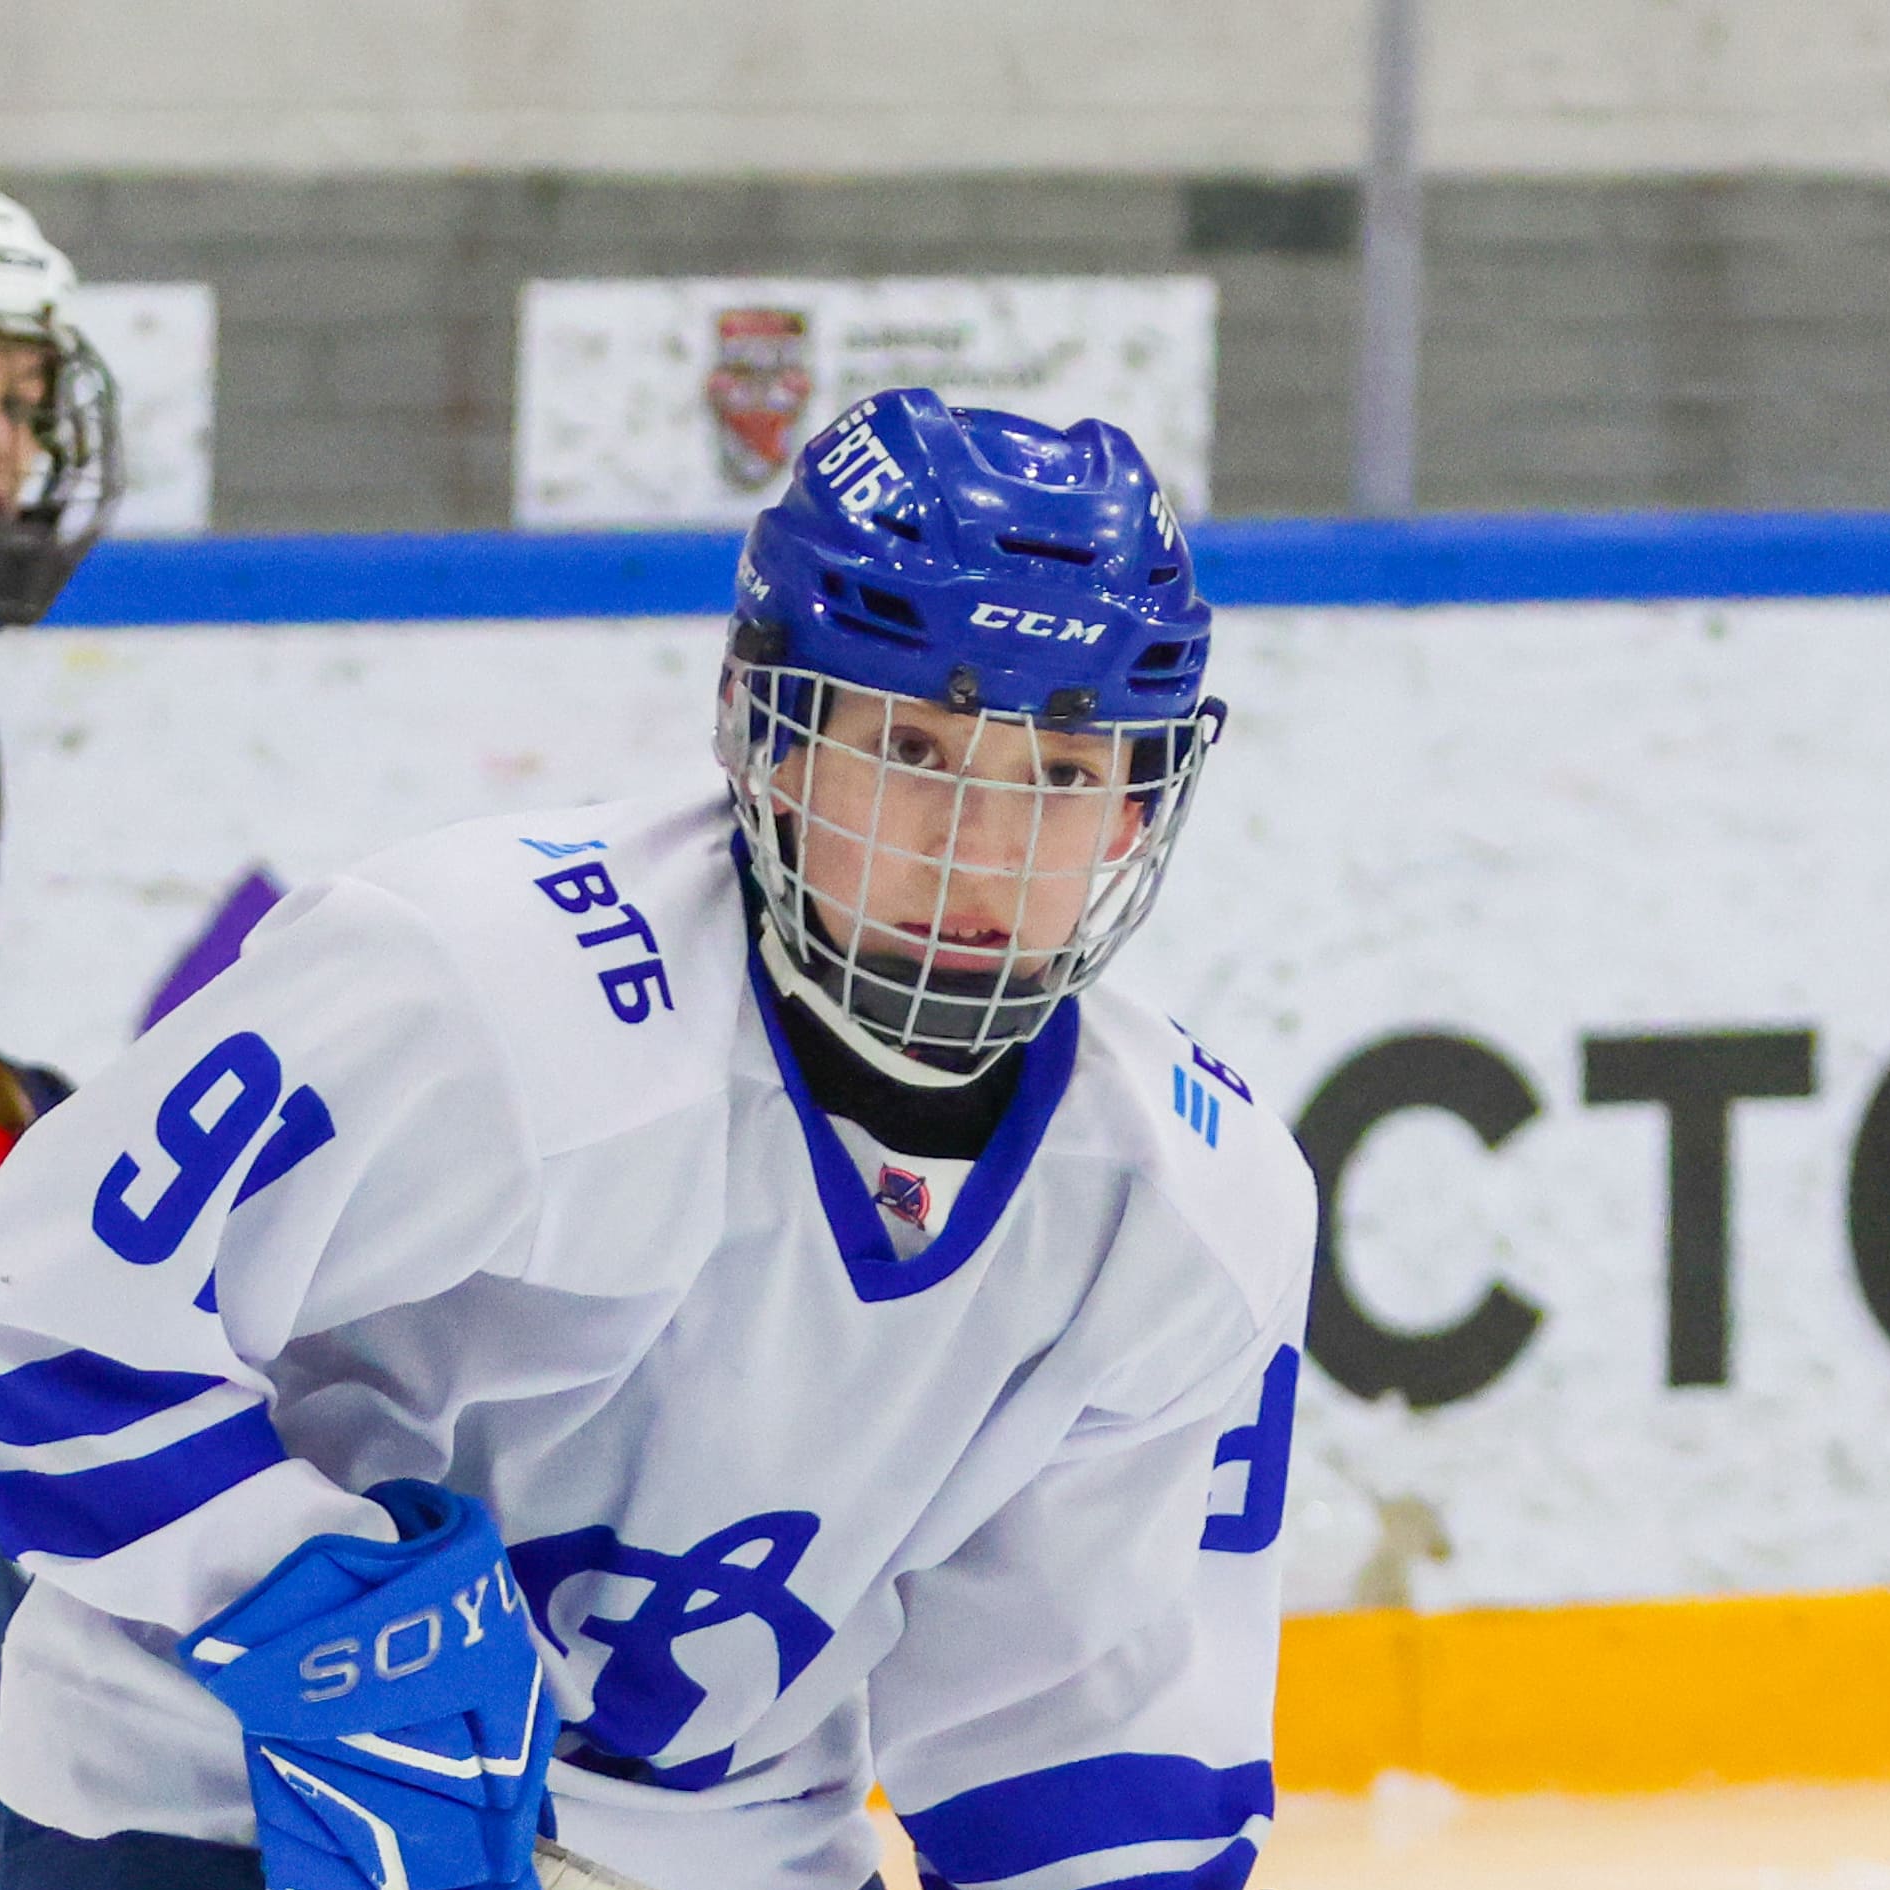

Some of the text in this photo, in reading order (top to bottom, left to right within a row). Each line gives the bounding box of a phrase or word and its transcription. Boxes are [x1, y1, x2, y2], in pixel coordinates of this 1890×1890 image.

[817, 421, 905, 513] ВТБ
[970, 602, 1107, 645] CCM
[533, 860, 675, 1025] ВТБ
